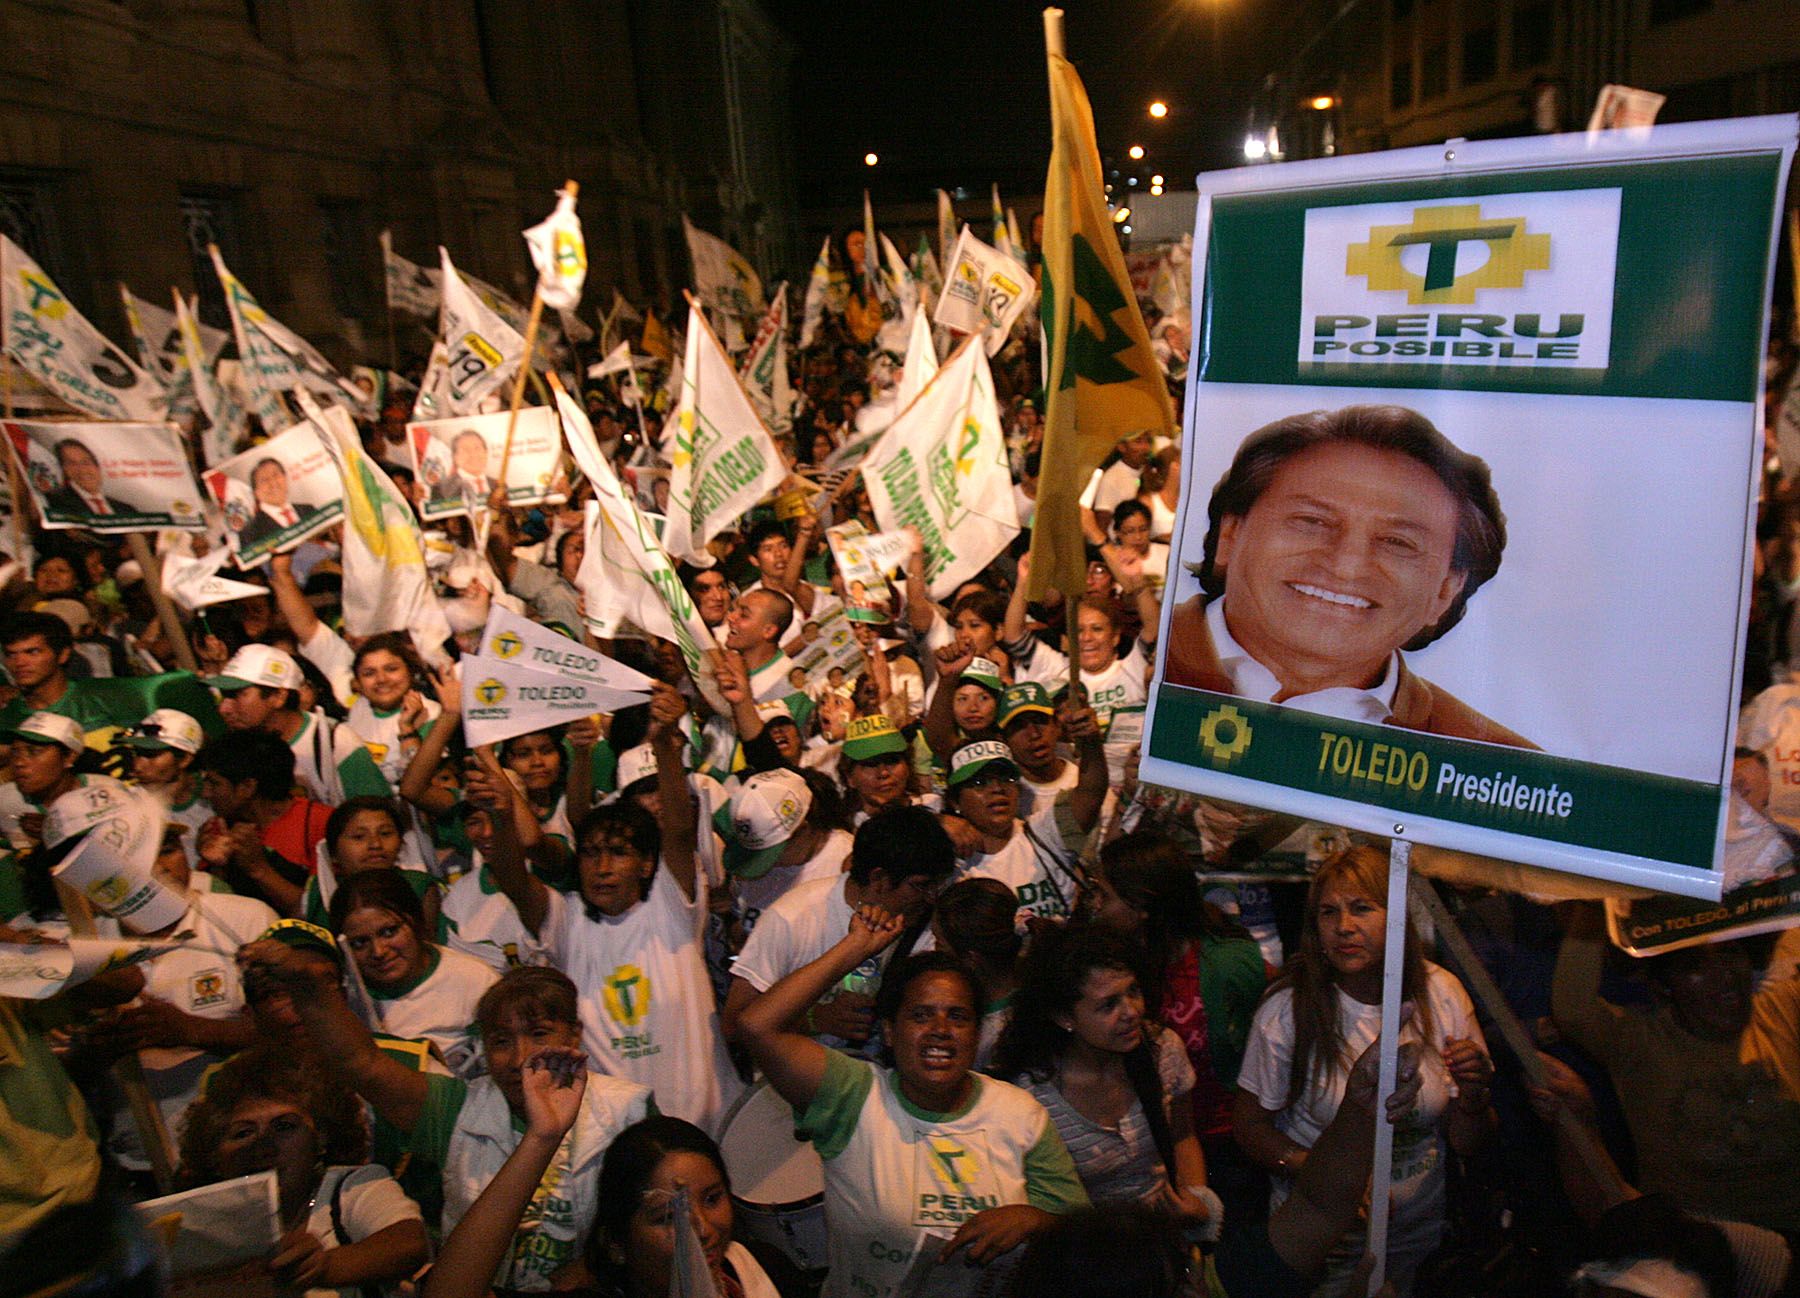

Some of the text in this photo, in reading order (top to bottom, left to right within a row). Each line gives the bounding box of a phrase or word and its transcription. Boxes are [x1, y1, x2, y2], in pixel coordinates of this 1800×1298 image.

[1313, 312, 1585, 339] PERU
[1313, 341, 1580, 360] POSIBLE
[449, 349, 487, 387] 19
[532, 647, 600, 672] TOLEDO
[518, 686, 587, 701] TOLEDO
[1319, 732, 1574, 818] TOLEDO Presidente
